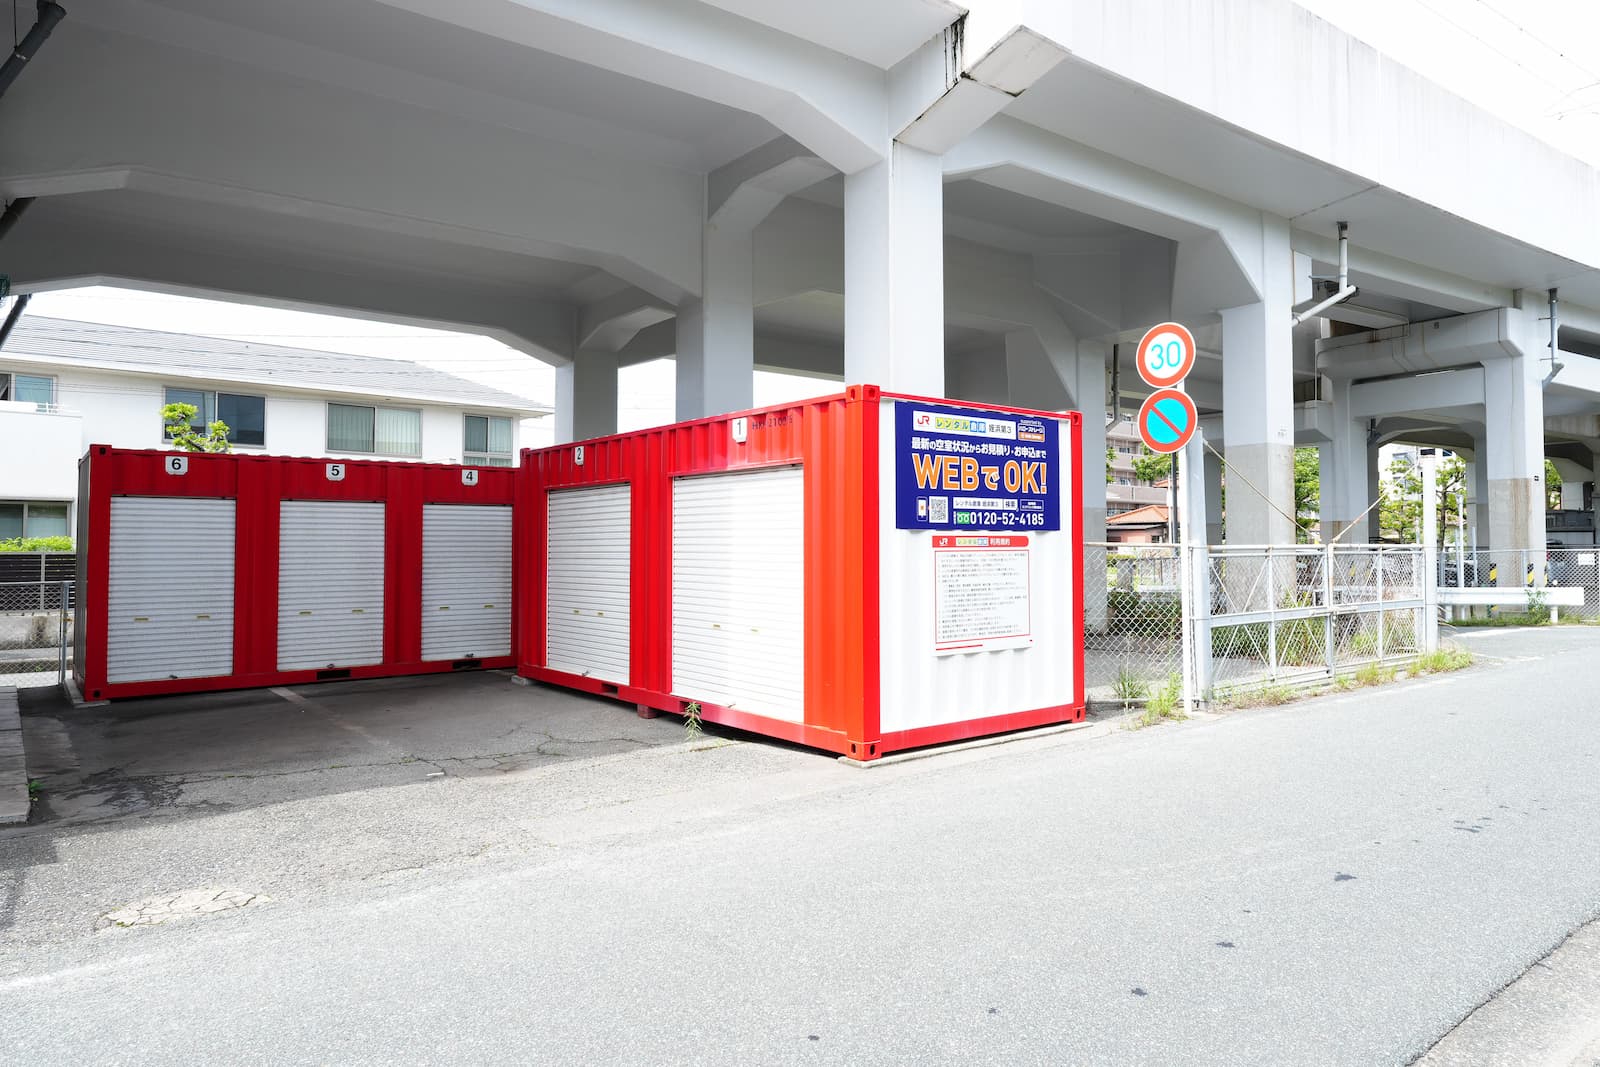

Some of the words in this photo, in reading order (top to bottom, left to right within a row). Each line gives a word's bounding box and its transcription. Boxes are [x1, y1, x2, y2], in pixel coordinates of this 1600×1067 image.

[1150, 341, 1181, 370] 30
[917, 415, 930, 425] JR
[736, 419, 742, 436] 1
[577, 448, 582, 460] 2
[171, 457, 182, 470] 6
[331, 465, 340, 477] 5
[465, 471, 473, 481] 4
[969, 511, 1044, 526] 0120-52-4185
[939, 537, 949, 546] JR
